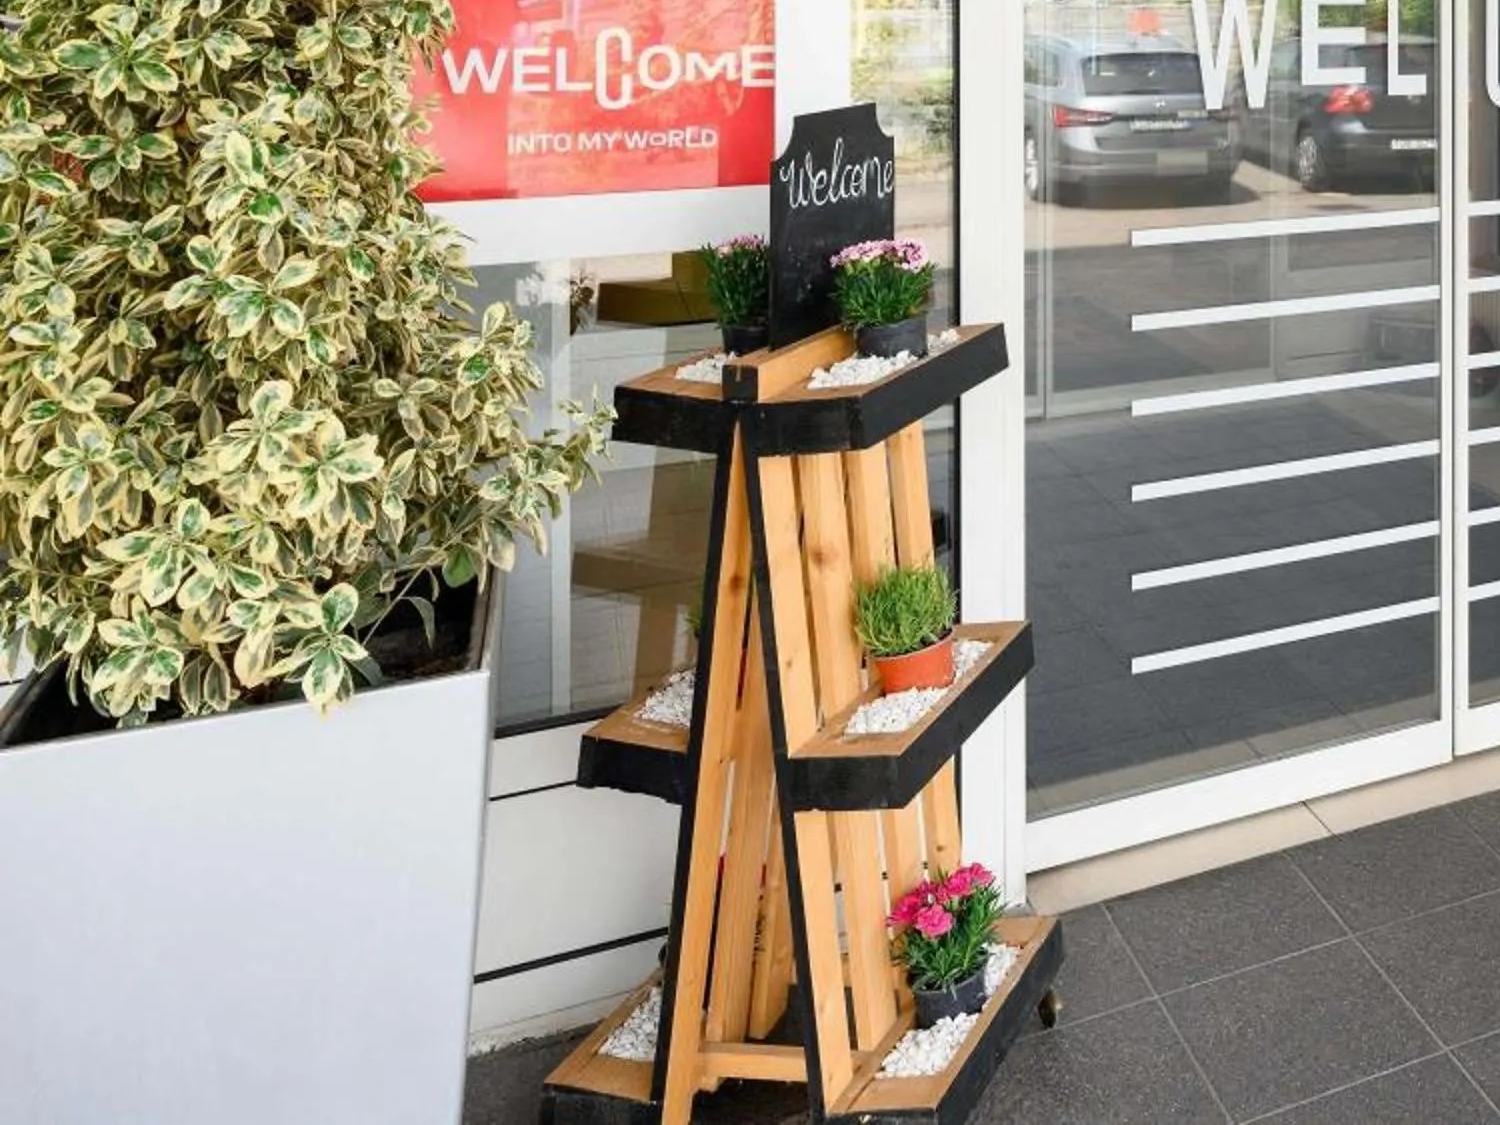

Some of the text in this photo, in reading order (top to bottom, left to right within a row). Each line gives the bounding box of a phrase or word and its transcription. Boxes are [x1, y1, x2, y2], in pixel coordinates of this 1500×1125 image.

[441, 27, 775, 110] WELCOME
[507, 126, 719, 155] INTO MY WORLD
[779, 136, 893, 209] Welcome
